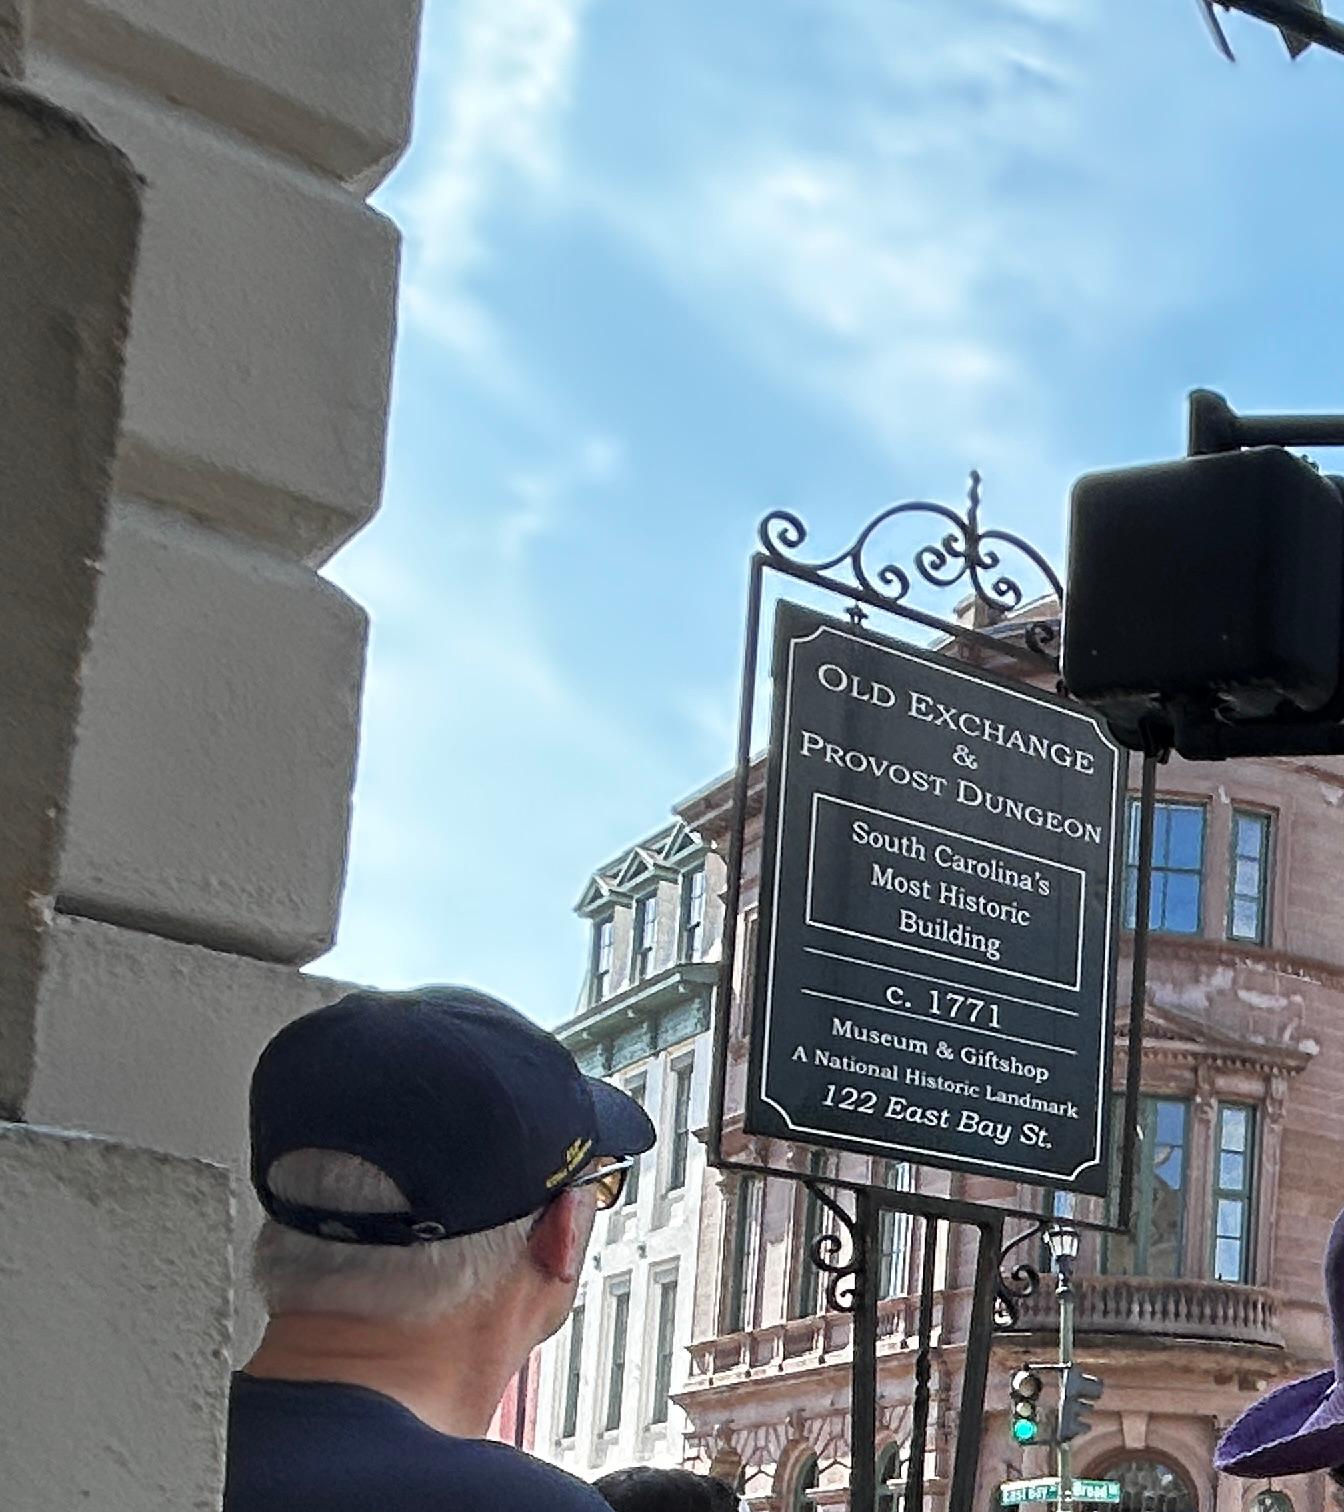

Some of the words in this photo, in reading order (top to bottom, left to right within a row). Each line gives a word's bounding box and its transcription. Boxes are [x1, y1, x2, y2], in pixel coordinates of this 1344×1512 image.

[818, 663, 896, 708] OLD
[908, 690, 1095, 775] EXCHANGE
[800, 730, 948, 797] PROVOST
[956, 778, 1102, 844] DUNGEON
[952, 744, 978, 770] &
[851, 820, 927, 862] South
[934, 844, 1050, 896] Carolina's
[870, 863, 931, 900] Most
[938, 882, 1032, 926] Historic
[899, 909, 1001, 961] Building
[928, 990, 1001, 1029] 1771
[791, 1046, 808, 1062] A
[814, 1049, 899, 1081] National
[904, 1068, 980, 1098] Historic
[985, 1084, 1080, 1119] Landmark
[832, 1016, 928, 1056] Museum
[936, 1040, 954, 1060] &
[960, 1046, 1050, 1084] Giftshop
[821, 1084, 878, 1114] 122
[884, 1096, 951, 1128] East
[956, 1110, 1012, 1145] Bay
[1019, 1122, 1052, 1149] St.
